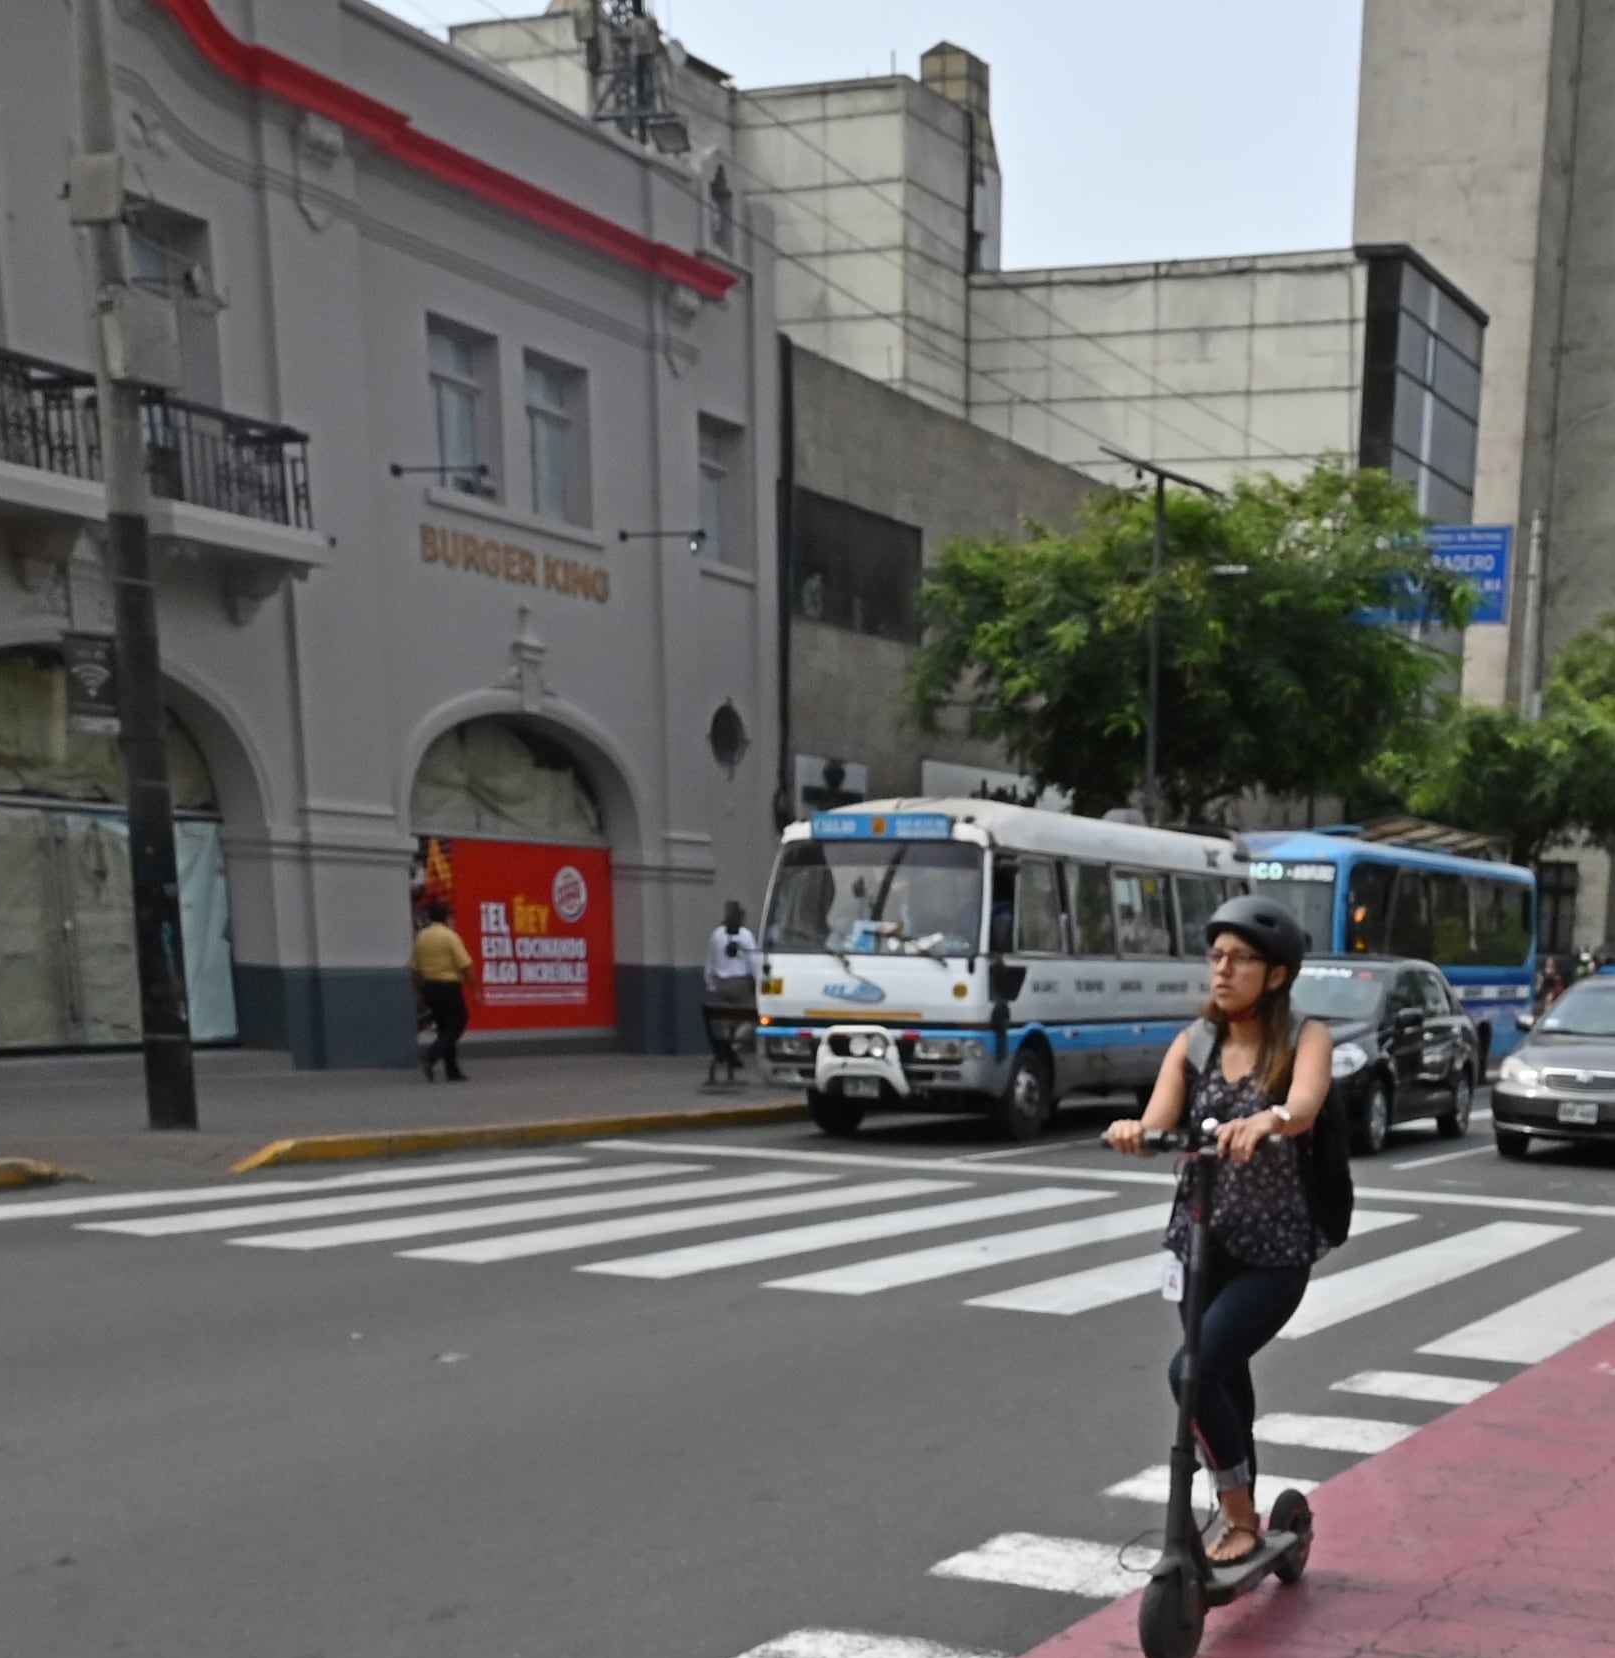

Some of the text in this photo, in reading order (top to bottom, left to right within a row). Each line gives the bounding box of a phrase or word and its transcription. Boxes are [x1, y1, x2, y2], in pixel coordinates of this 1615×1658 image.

[419, 521, 611, 605] BURGER KING
[514, 900, 550, 935] REY
[483, 960, 519, 984] ALGO
